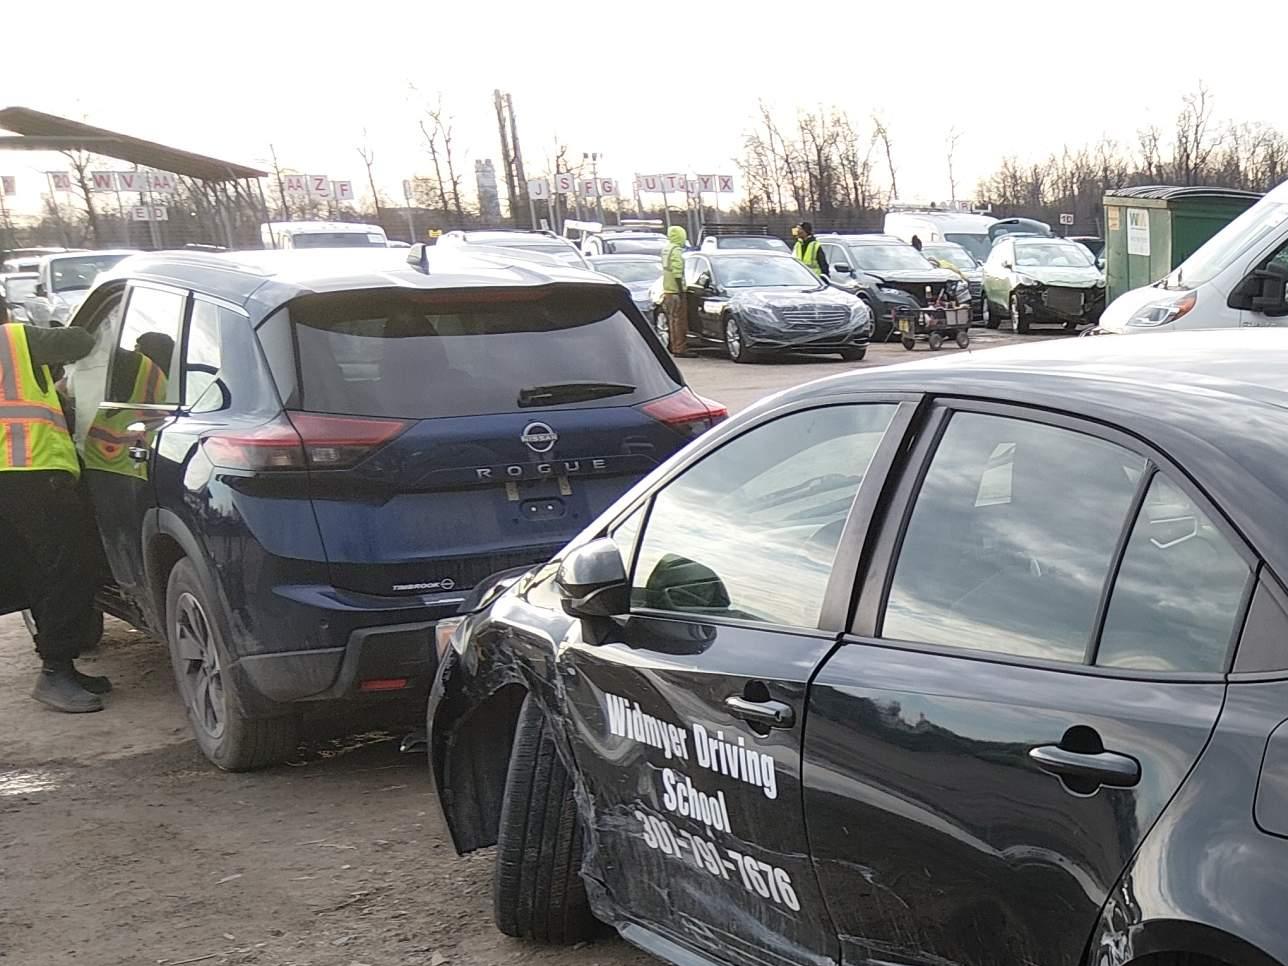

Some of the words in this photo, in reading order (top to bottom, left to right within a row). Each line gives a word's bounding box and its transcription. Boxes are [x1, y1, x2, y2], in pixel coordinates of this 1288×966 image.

[95, 175, 111, 188] W
[122, 175, 134, 188] V
[288, 179, 303, 191] AA
[315, 178, 326, 191] Z
[560, 178, 570, 190] S
[602, 181, 613, 193] G
[645, 178, 656, 190] U
[667, 176, 676, 188] T
[700, 178, 710, 189] Y
[722, 178, 732, 190] X
[340, 184, 348, 197] F
[535, 184, 542, 195] J
[136, 208, 145, 218] E
[476, 459, 607, 478] ROGUE
[605, 692, 688, 760] Widmyer
[693, 723, 778, 800] Driving
[663, 767, 731, 834] School
[634, 810, 800, 911] 301-791-7676
